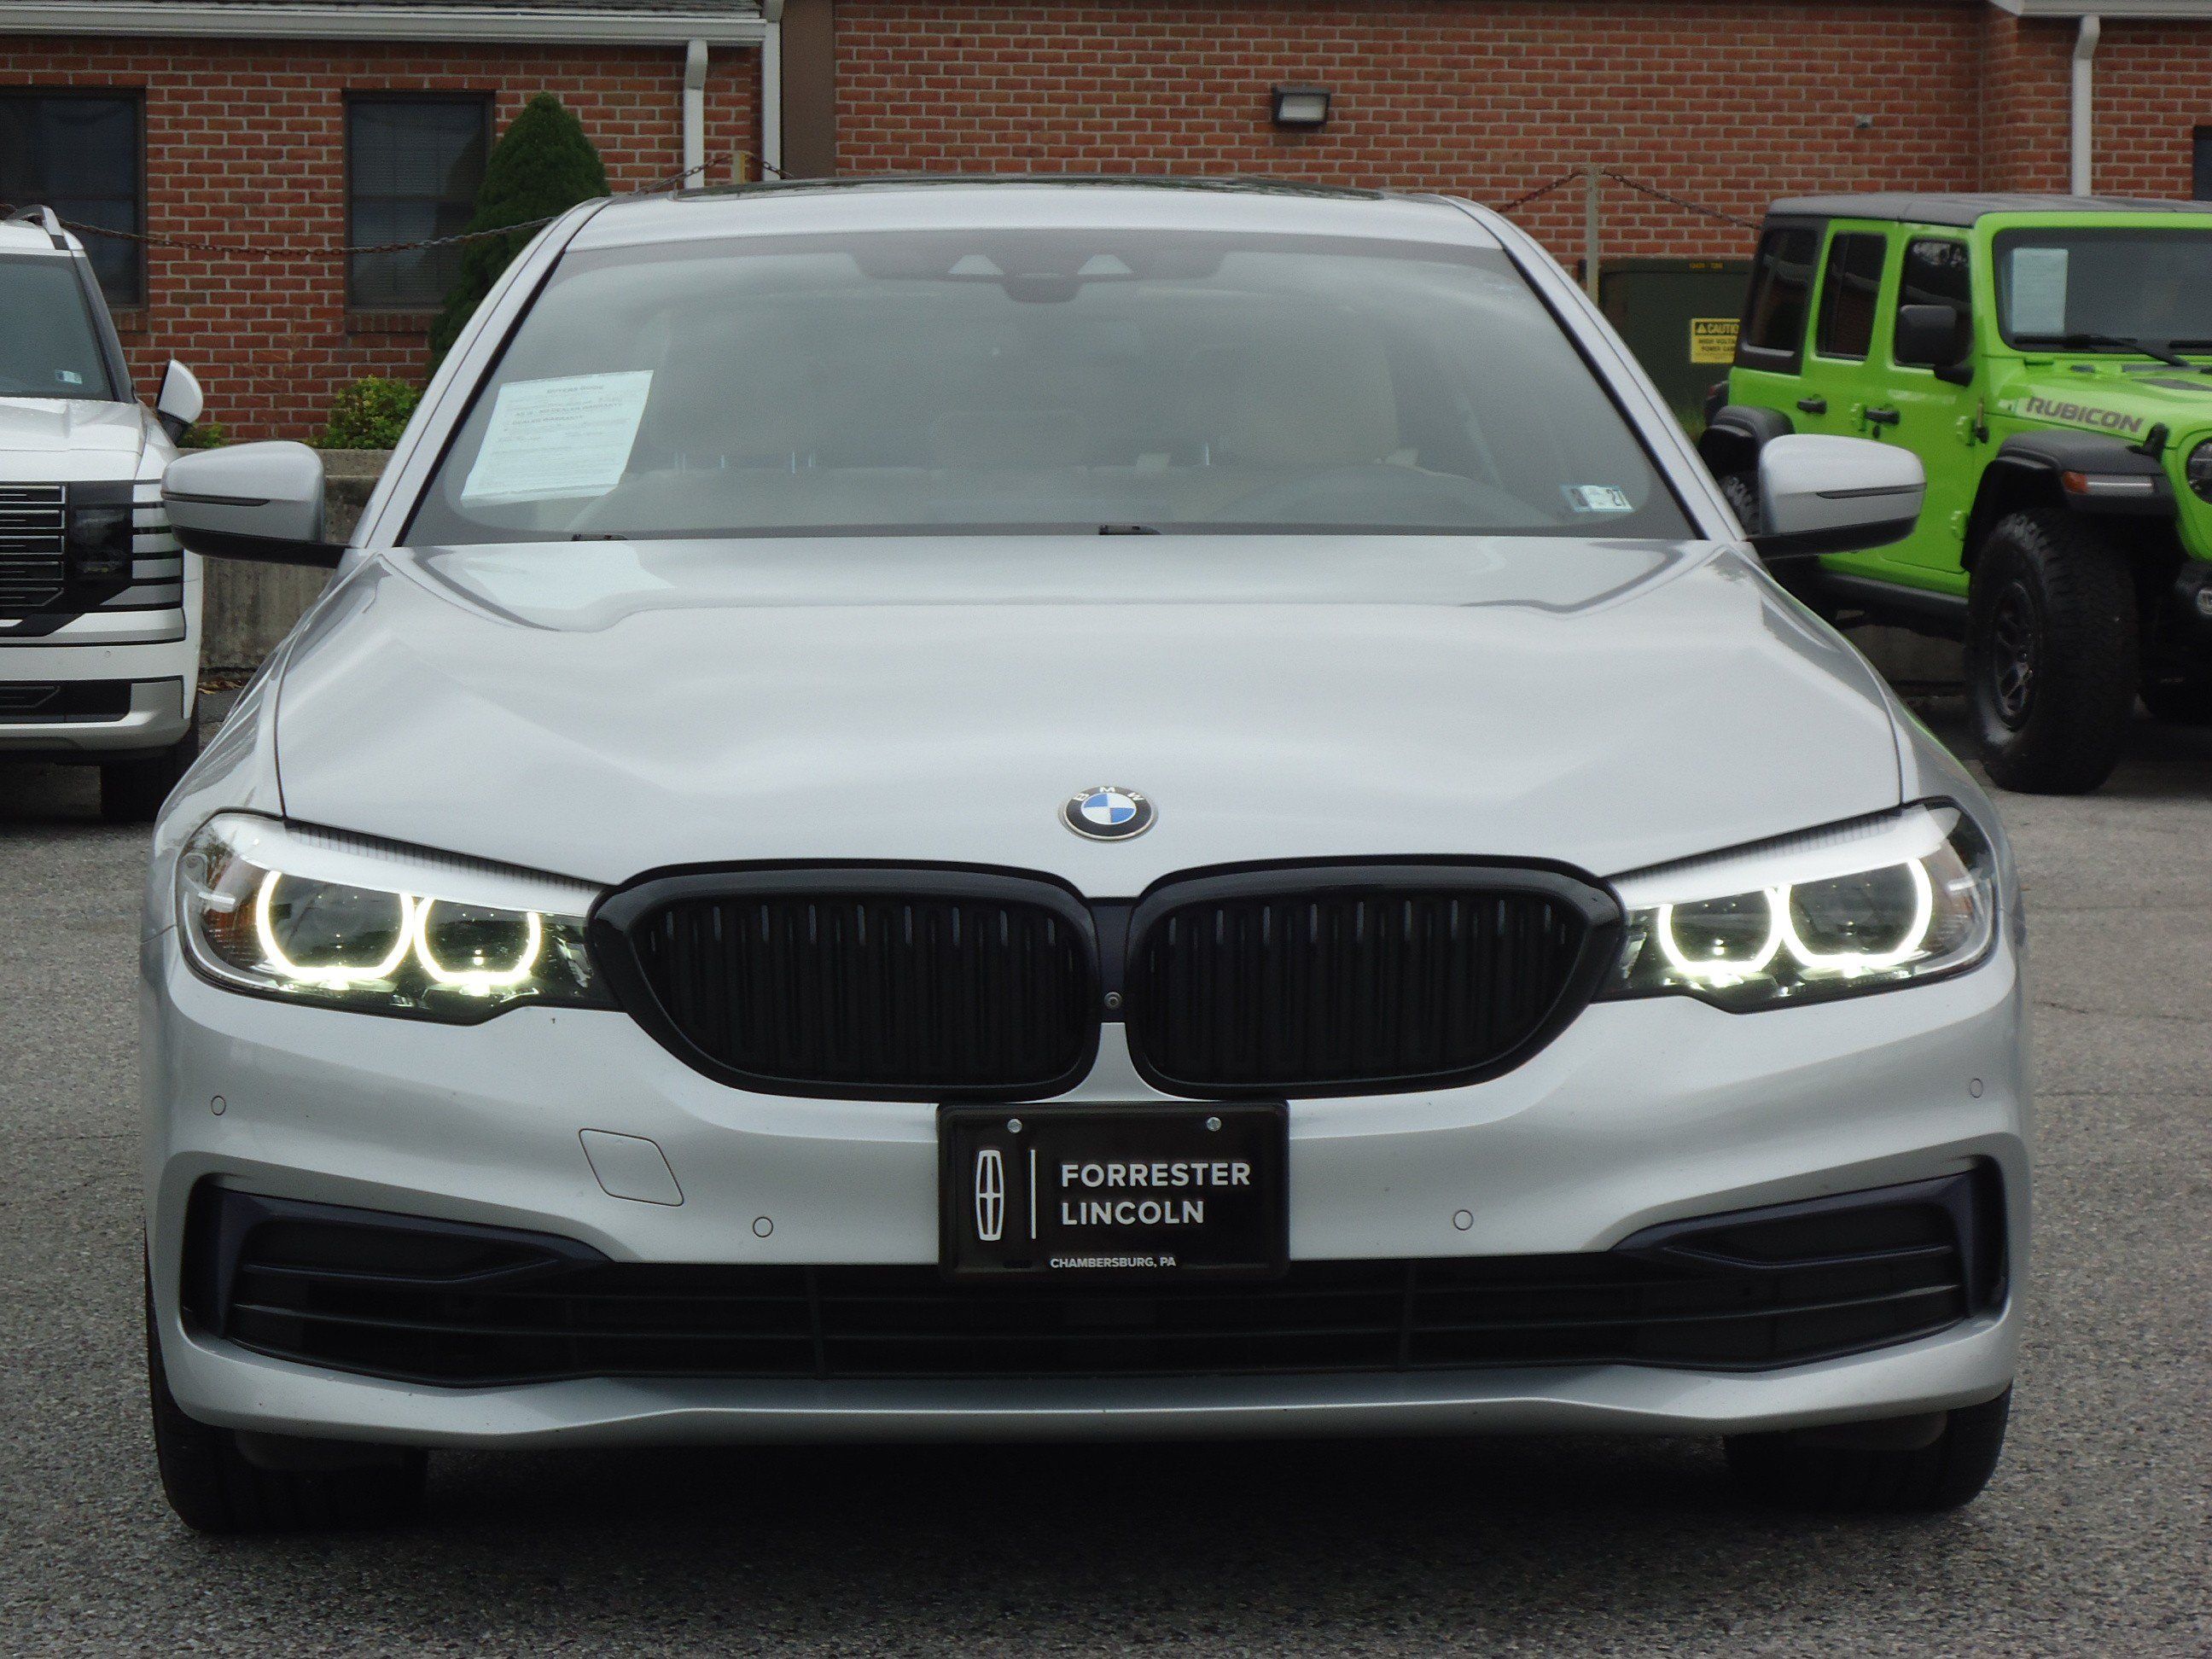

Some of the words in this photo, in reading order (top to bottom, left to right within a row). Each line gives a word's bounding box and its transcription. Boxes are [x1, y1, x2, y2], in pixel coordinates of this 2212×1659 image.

[1708, 323, 1739, 334] CAUTIO
[2026, 396, 2145, 434] RUBICON
[1073, 786, 1144, 802] BMW
[1062, 1161, 1251, 1187] FORRESTER
[1062, 1200, 1204, 1225] LINCOLN
[1050, 1256, 1156, 1269] CHAMBERSBURG,
[1160, 1256, 1177, 1267] PA
